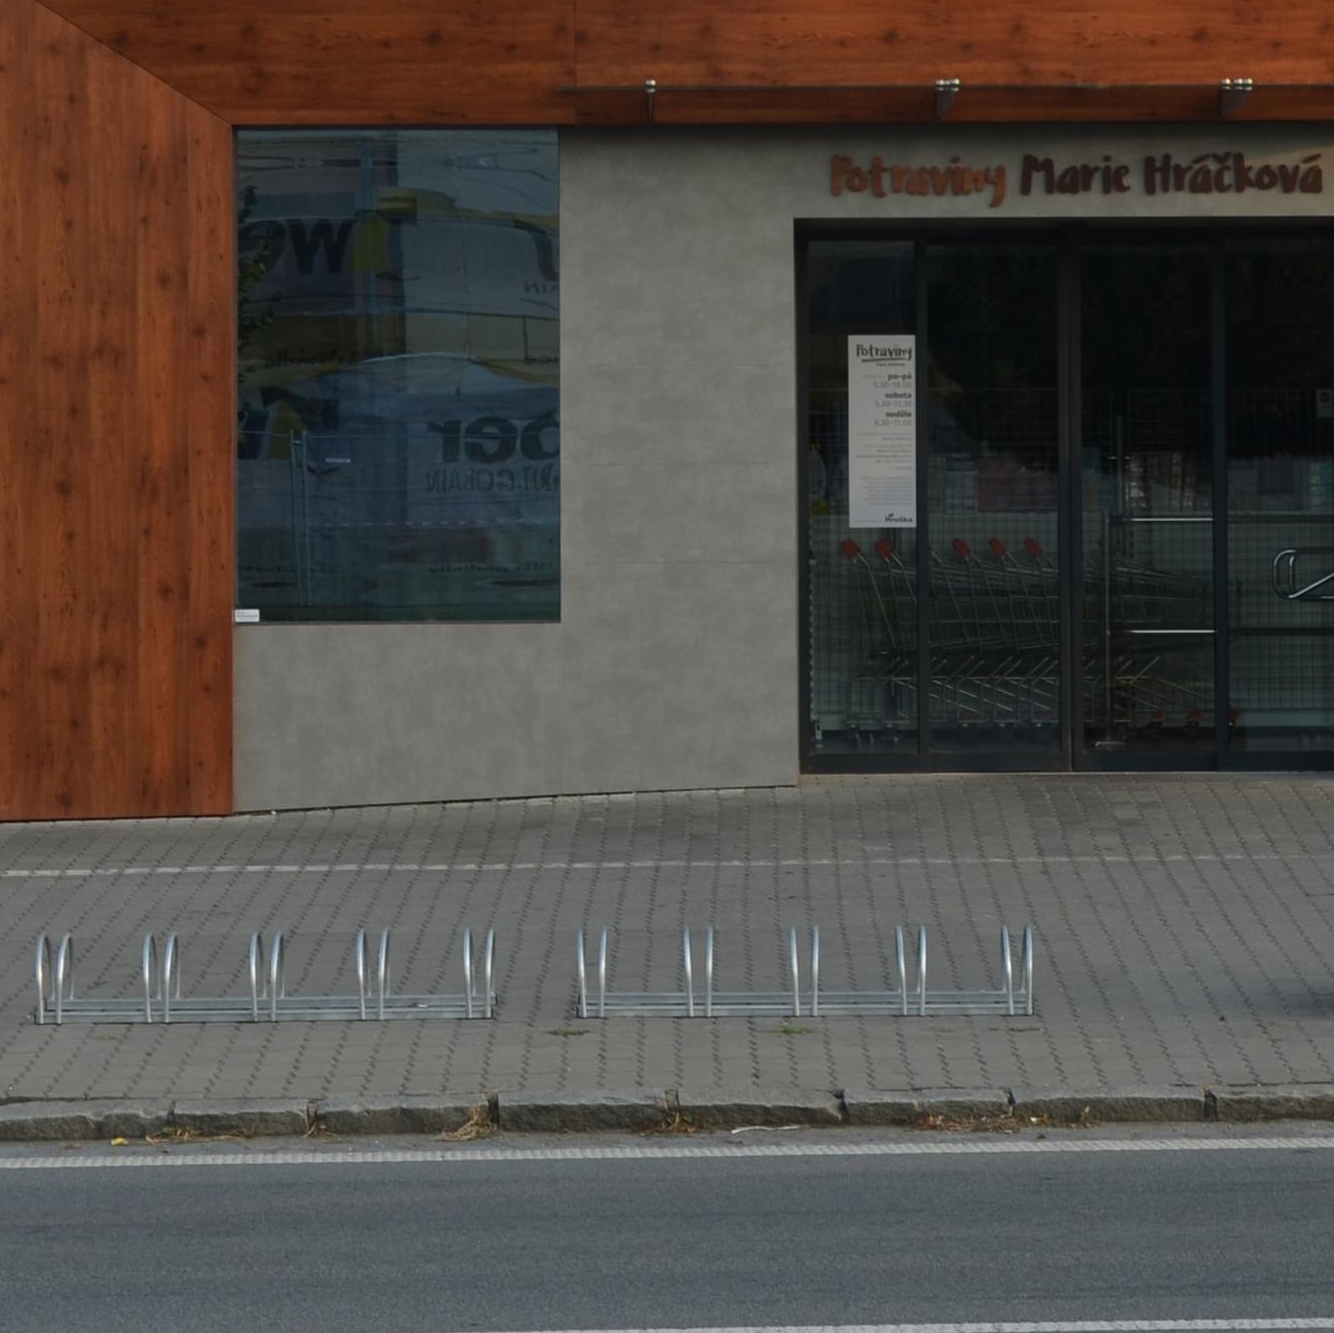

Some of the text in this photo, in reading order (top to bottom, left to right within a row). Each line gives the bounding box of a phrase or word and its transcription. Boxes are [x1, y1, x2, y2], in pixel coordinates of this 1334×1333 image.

[830, 152, 1323, 208] Potraviny Marie Hráčková
[856, 344, 912, 362] Potraviny
